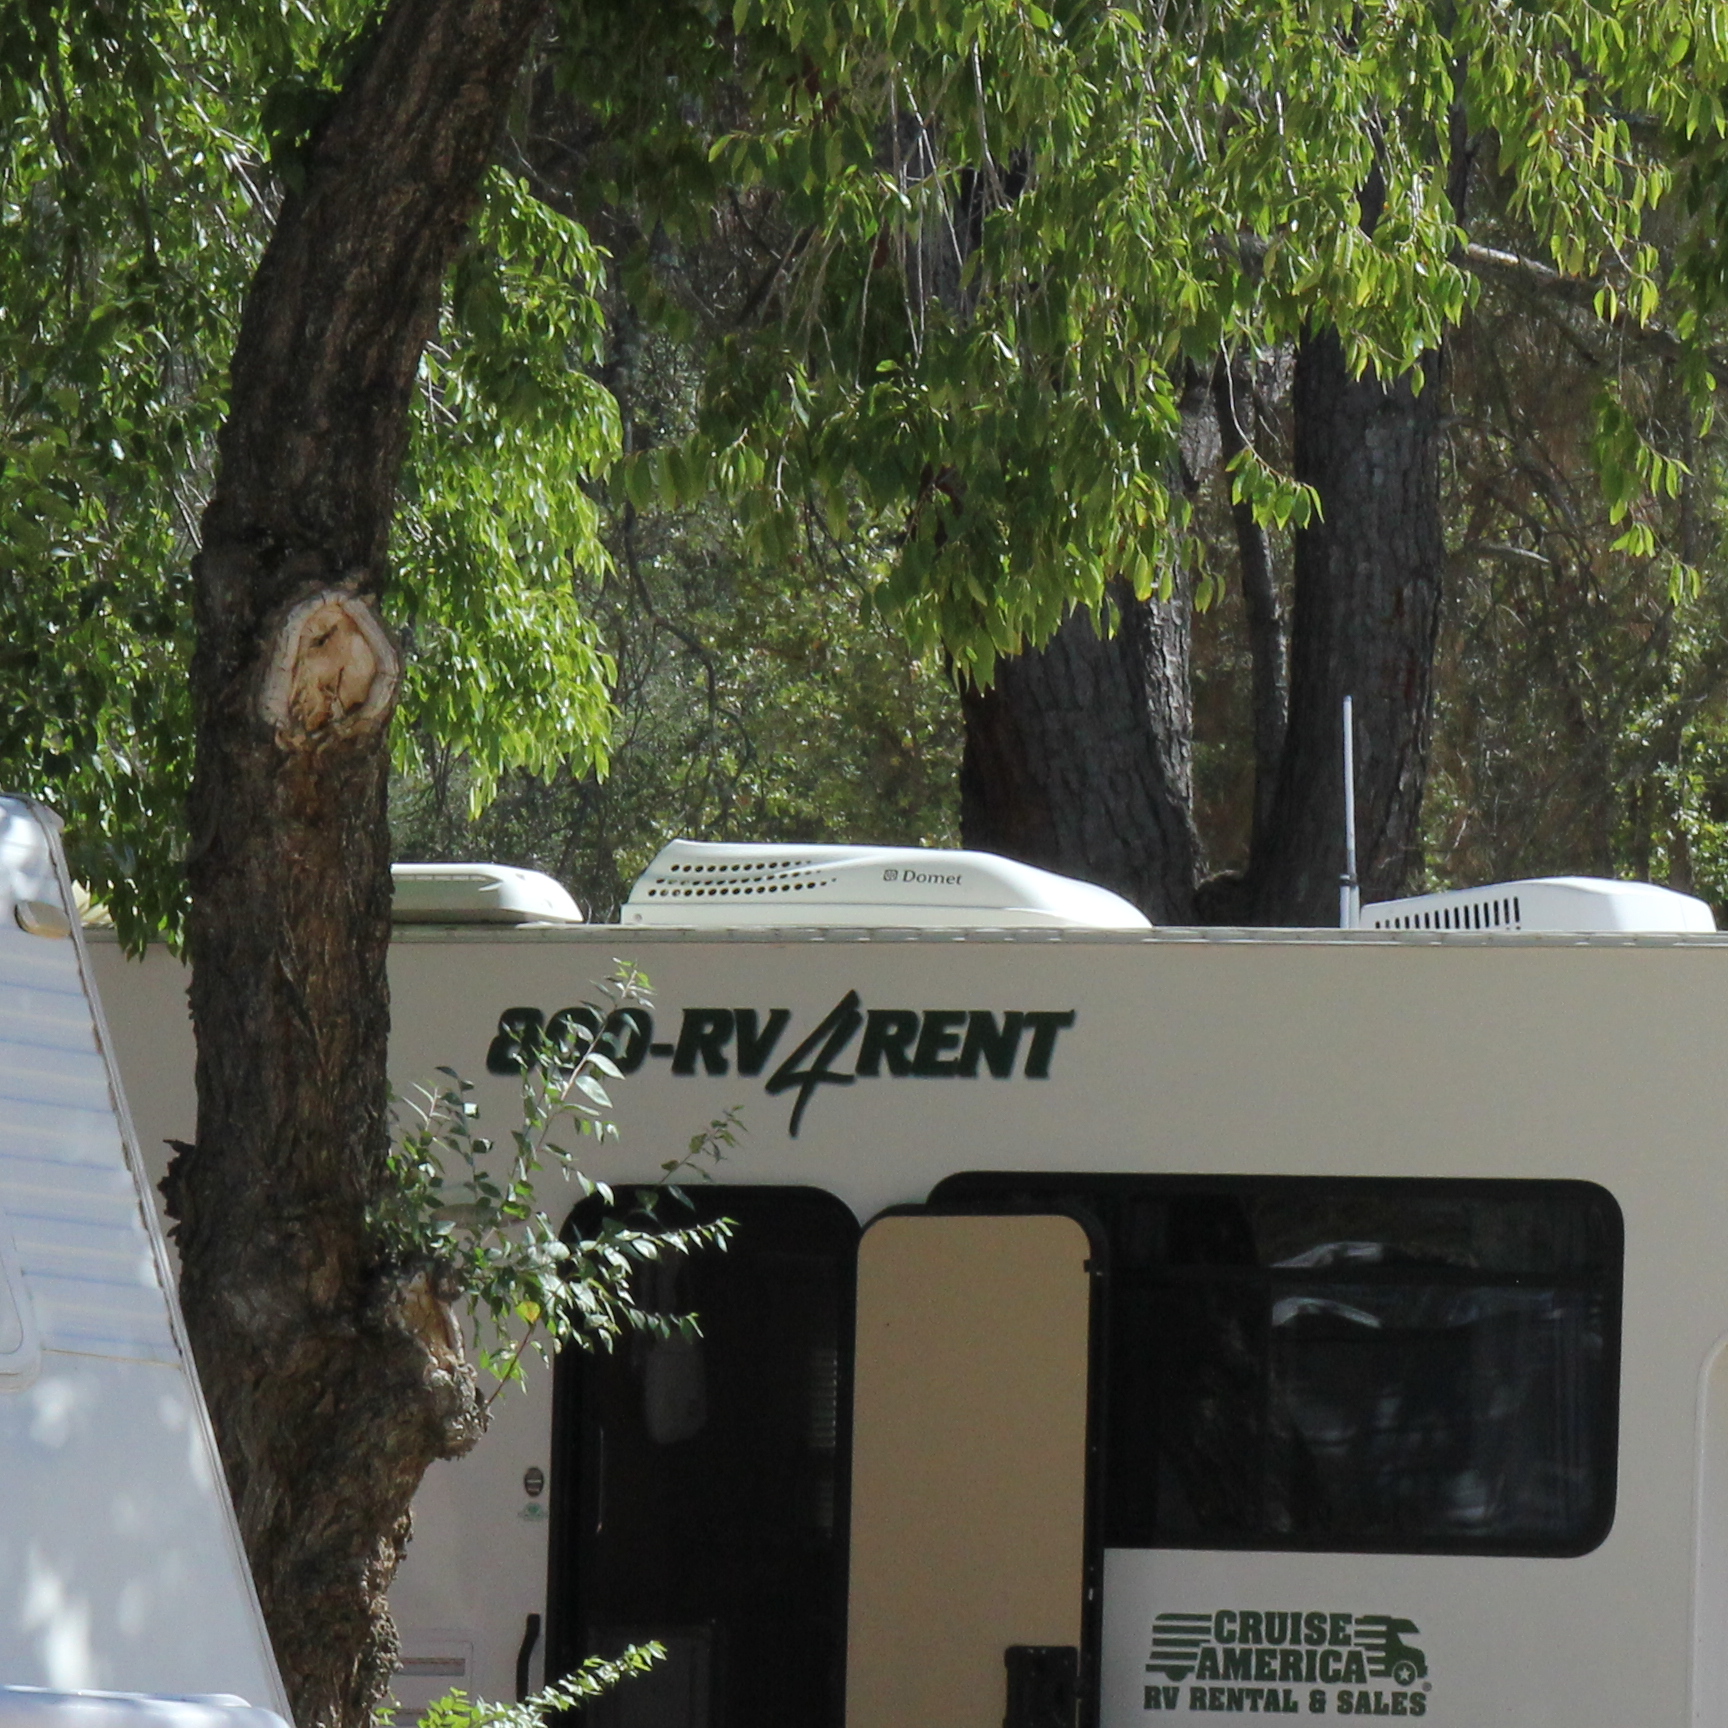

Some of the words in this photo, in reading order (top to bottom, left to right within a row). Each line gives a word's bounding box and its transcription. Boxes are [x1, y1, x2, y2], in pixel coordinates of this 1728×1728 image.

[1213, 1609, 1353, 1647] CRUISE
[1195, 1647, 1368, 1684] AMERICA
[1143, 1685, 1180, 1711] RV
[1189, 1686, 1299, 1714] RENTAL
[1308, 1689, 1327, 1714] &
[1336, 1690, 1427, 1717] SALES
